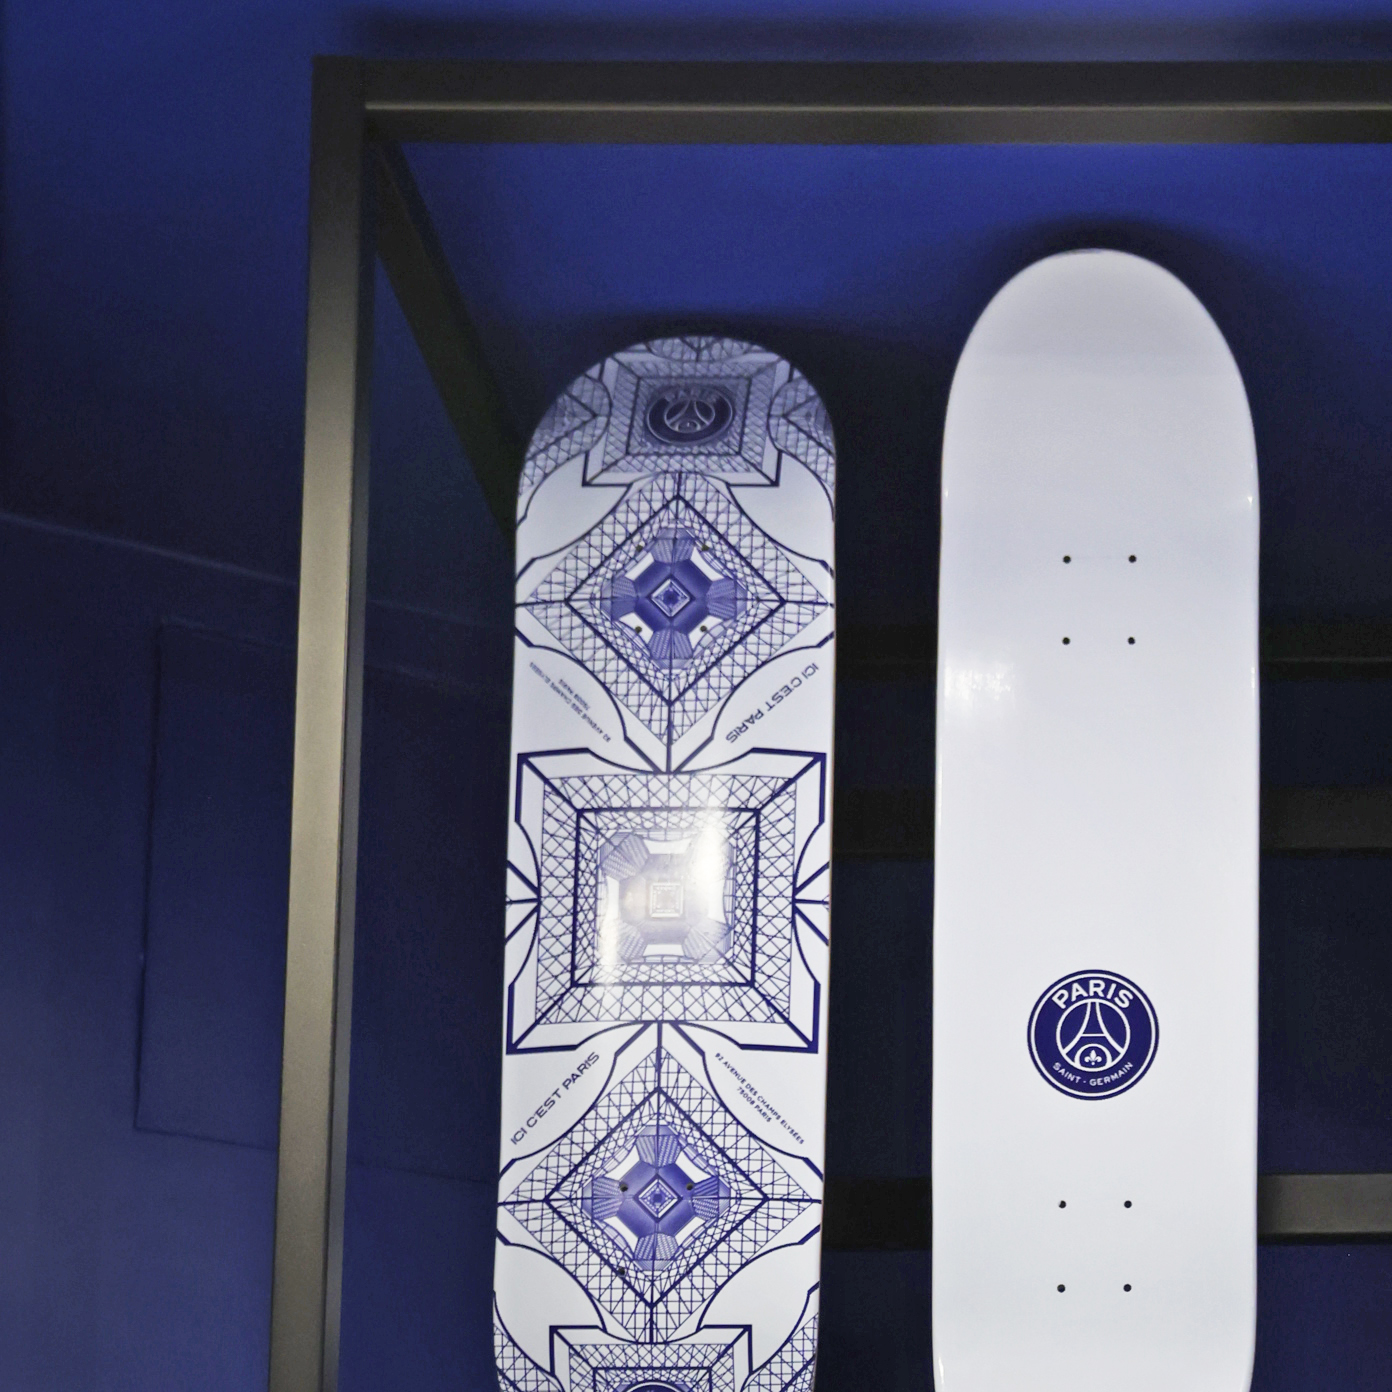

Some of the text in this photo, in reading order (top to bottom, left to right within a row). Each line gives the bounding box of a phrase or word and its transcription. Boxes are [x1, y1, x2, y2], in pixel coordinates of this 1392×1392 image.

[801, 662, 819, 680] ICI
[725, 708, 764, 744] PARIS
[1051, 979, 1134, 1010] PARIS
[1052, 1061, 1134, 1087] SAINT GERMAIN
[510, 1127, 528, 1145] ICI
[562, 1051, 600, 1091] PARIS
[722, 1060, 747, 1085] AVENUE
[744, 1083, 758, 1097] DES
[756, 1095, 782, 1121] CHAMPS
[754, 1104, 772, 1123] PARIS
